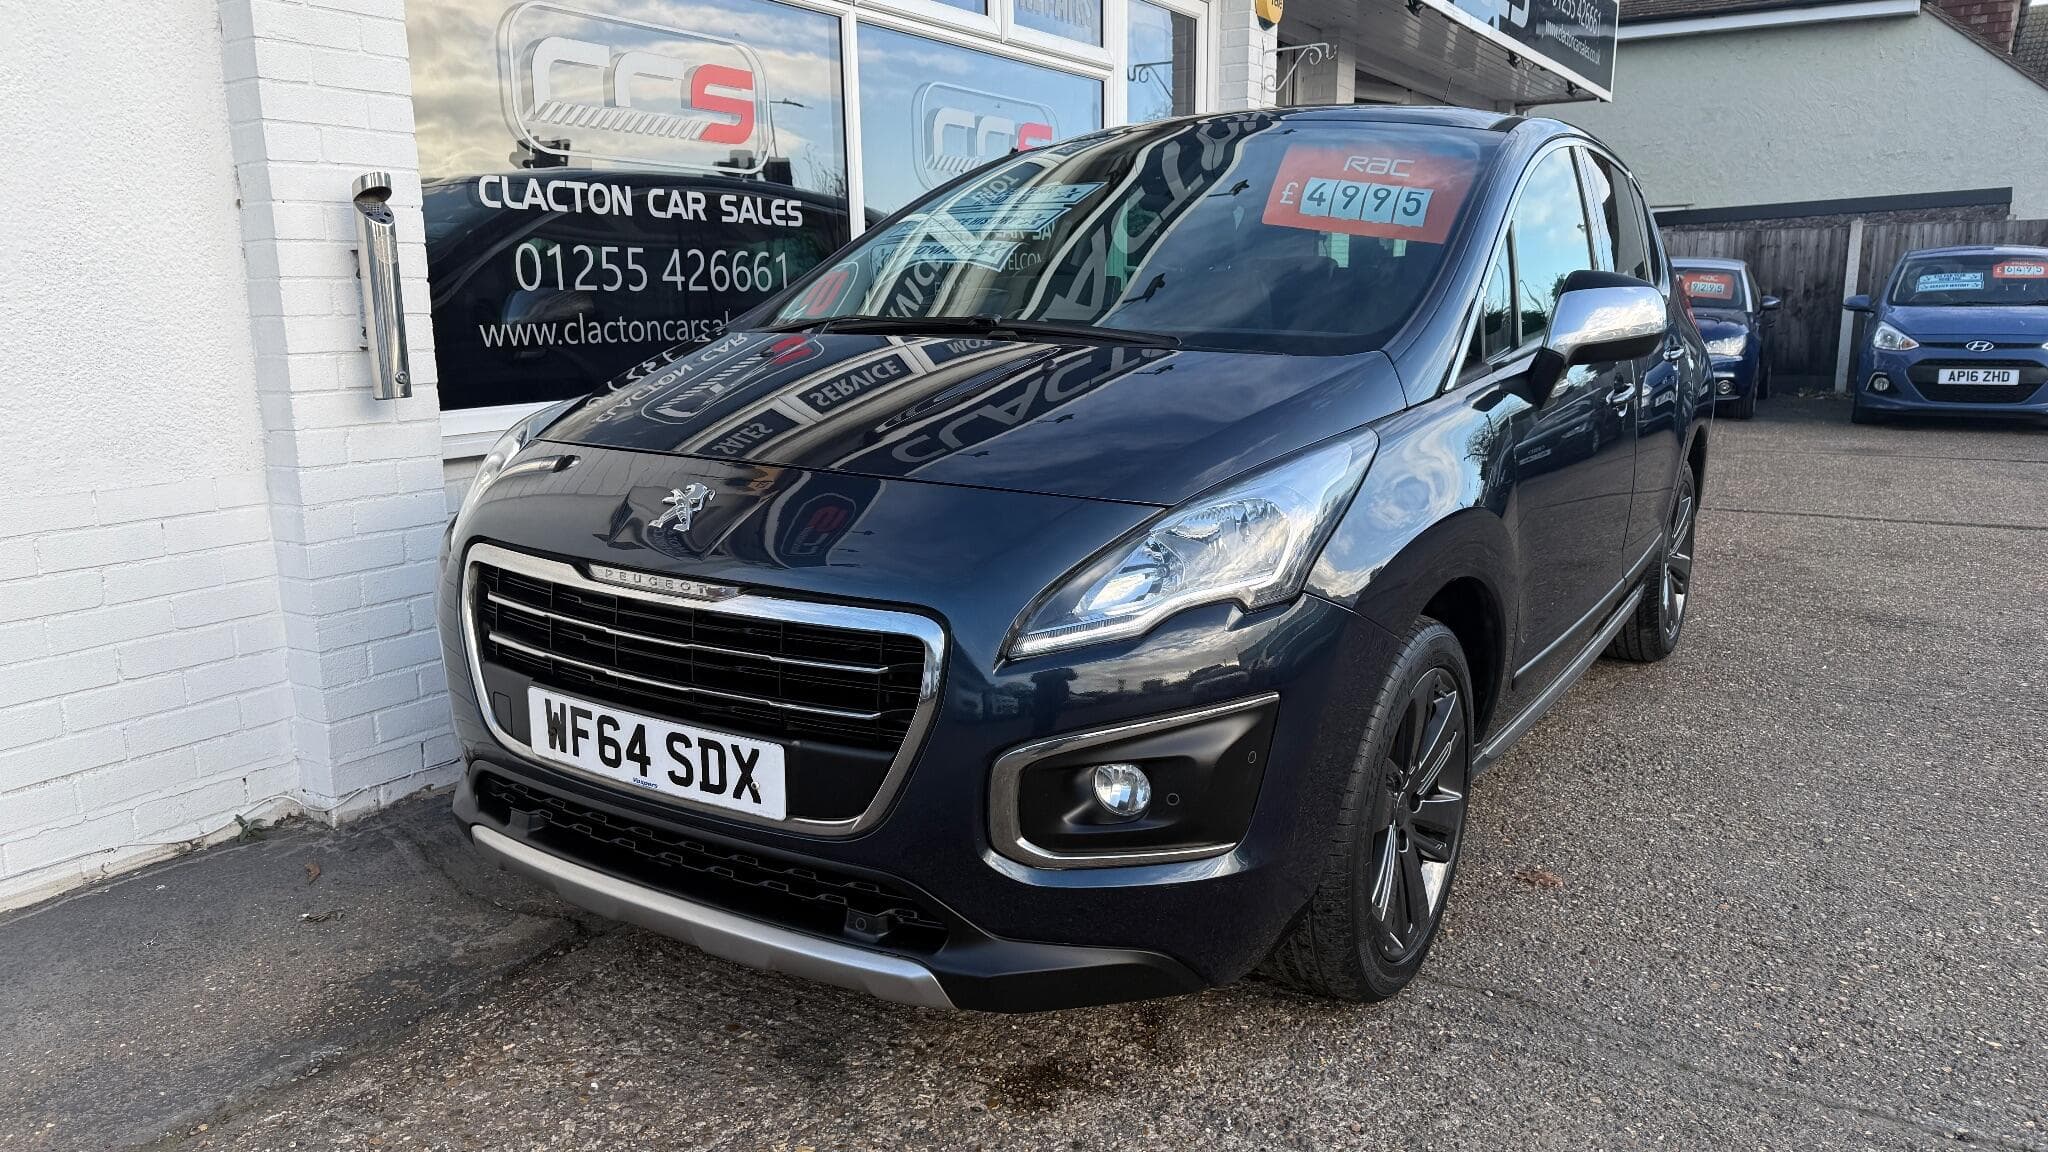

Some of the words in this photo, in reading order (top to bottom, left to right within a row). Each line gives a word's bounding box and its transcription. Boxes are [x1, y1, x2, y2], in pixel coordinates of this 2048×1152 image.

[477, 175, 633, 217] CLACTON
[647, 188, 707, 222] CAR
[720, 194, 803, 228] SALES
[515, 243, 649, 293] 01255
[662, 248, 790, 293] 426661
[1948, 370, 1979, 382] AP16
[1982, 371, 2010, 382] ZHD
[605, 568, 708, 594] PEUGEOT
[544, 697, 651, 778] WF64
[667, 731, 762, 805] SDX
